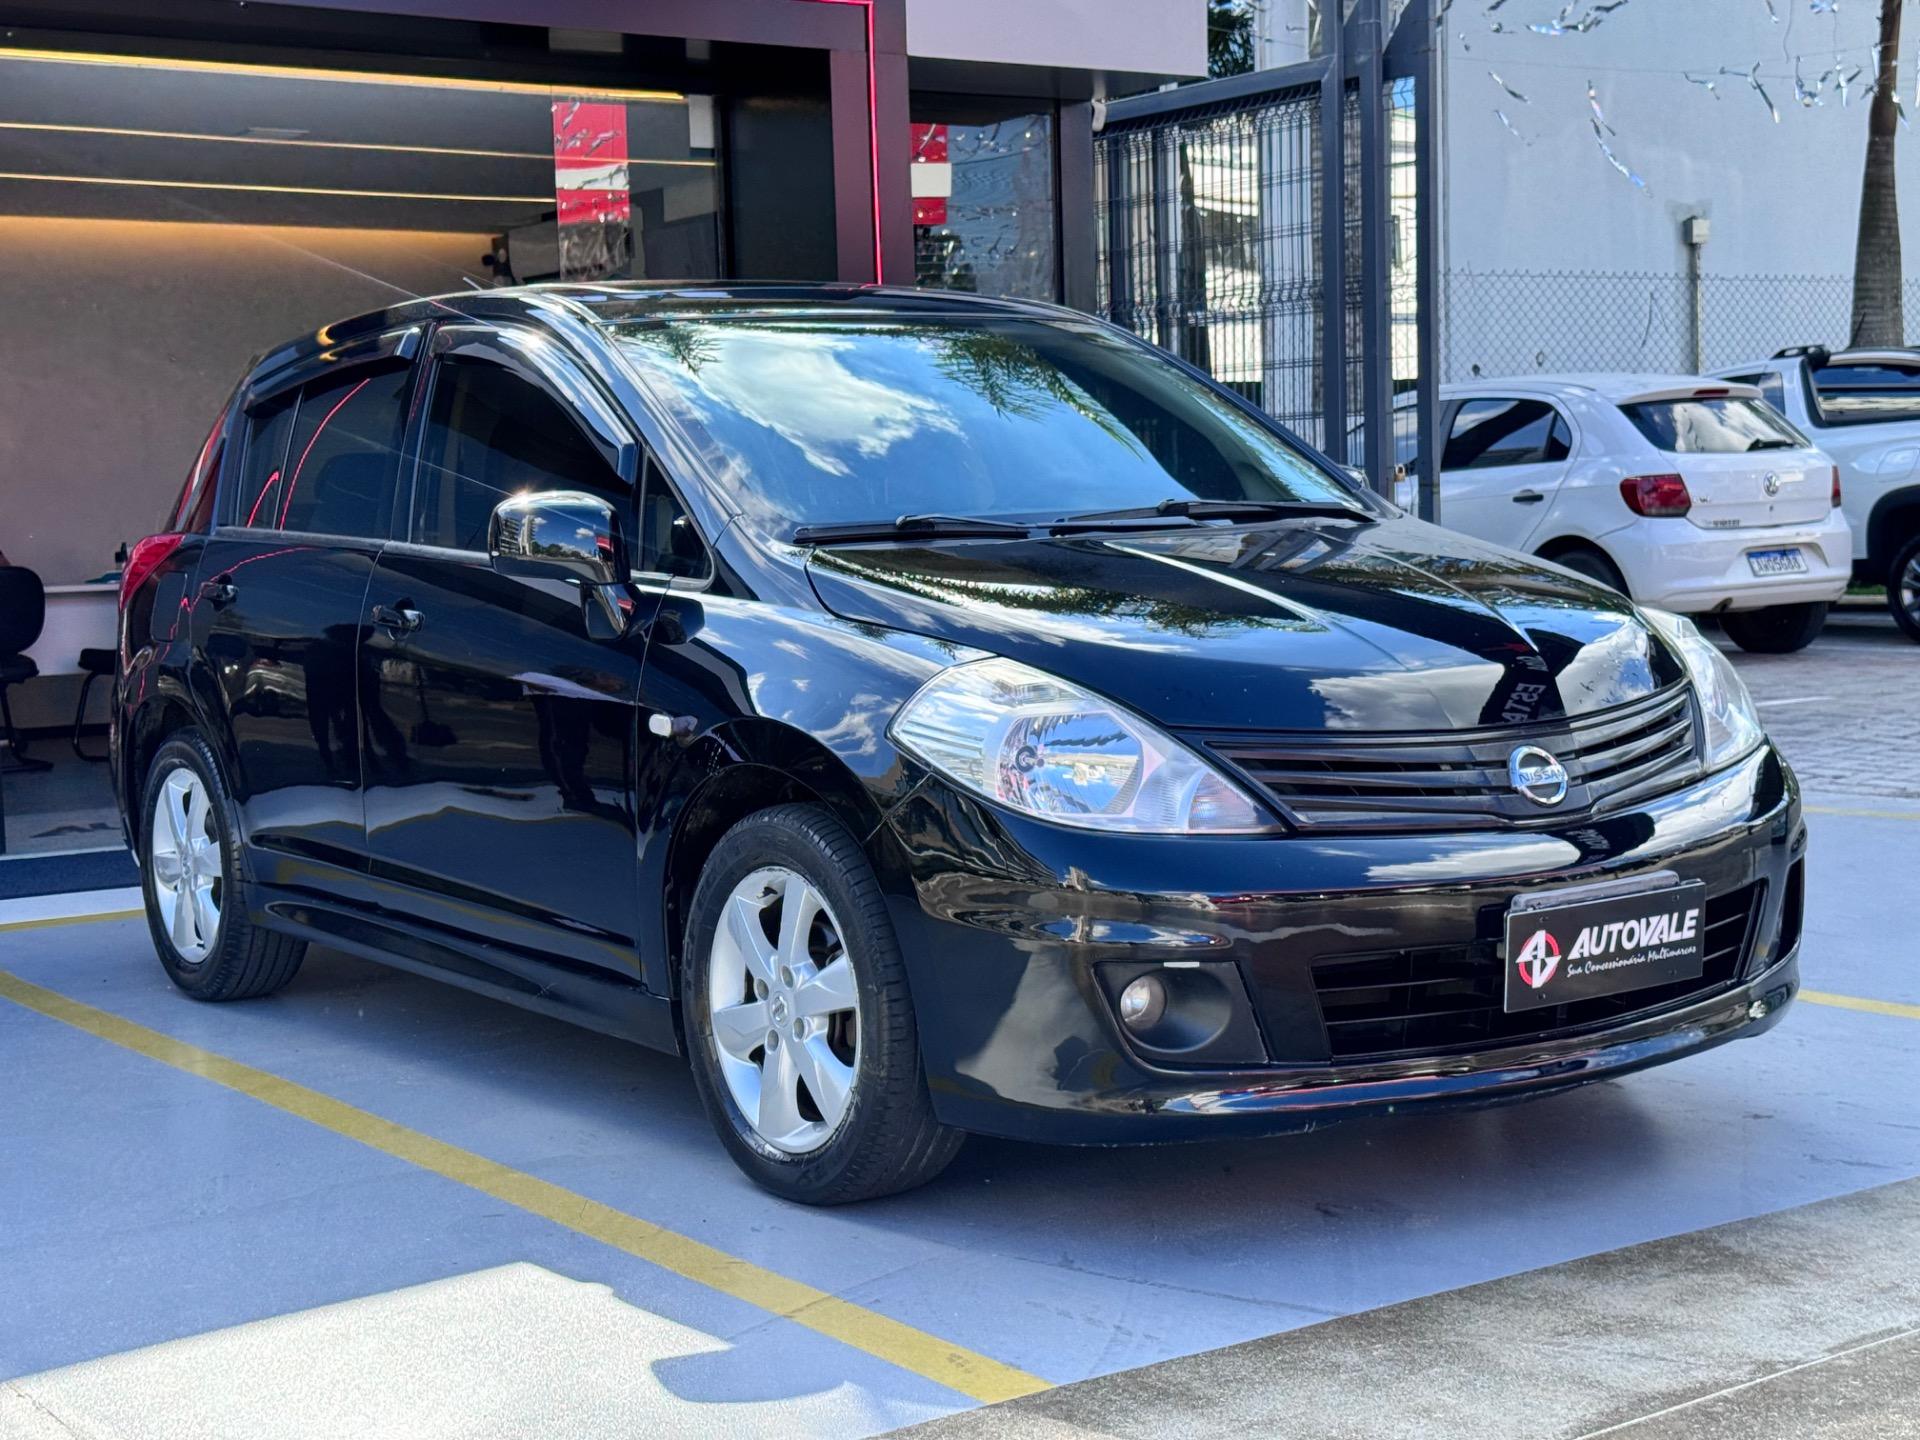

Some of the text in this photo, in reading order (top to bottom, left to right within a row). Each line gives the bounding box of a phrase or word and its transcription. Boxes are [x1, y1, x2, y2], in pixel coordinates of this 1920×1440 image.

[1518, 767, 1565, 783] NISSAN
[1567, 908, 1699, 960] AUTOVALE
[1567, 963, 1583, 978] Sua
[1647, 945, 1697, 963] Multimarcas
